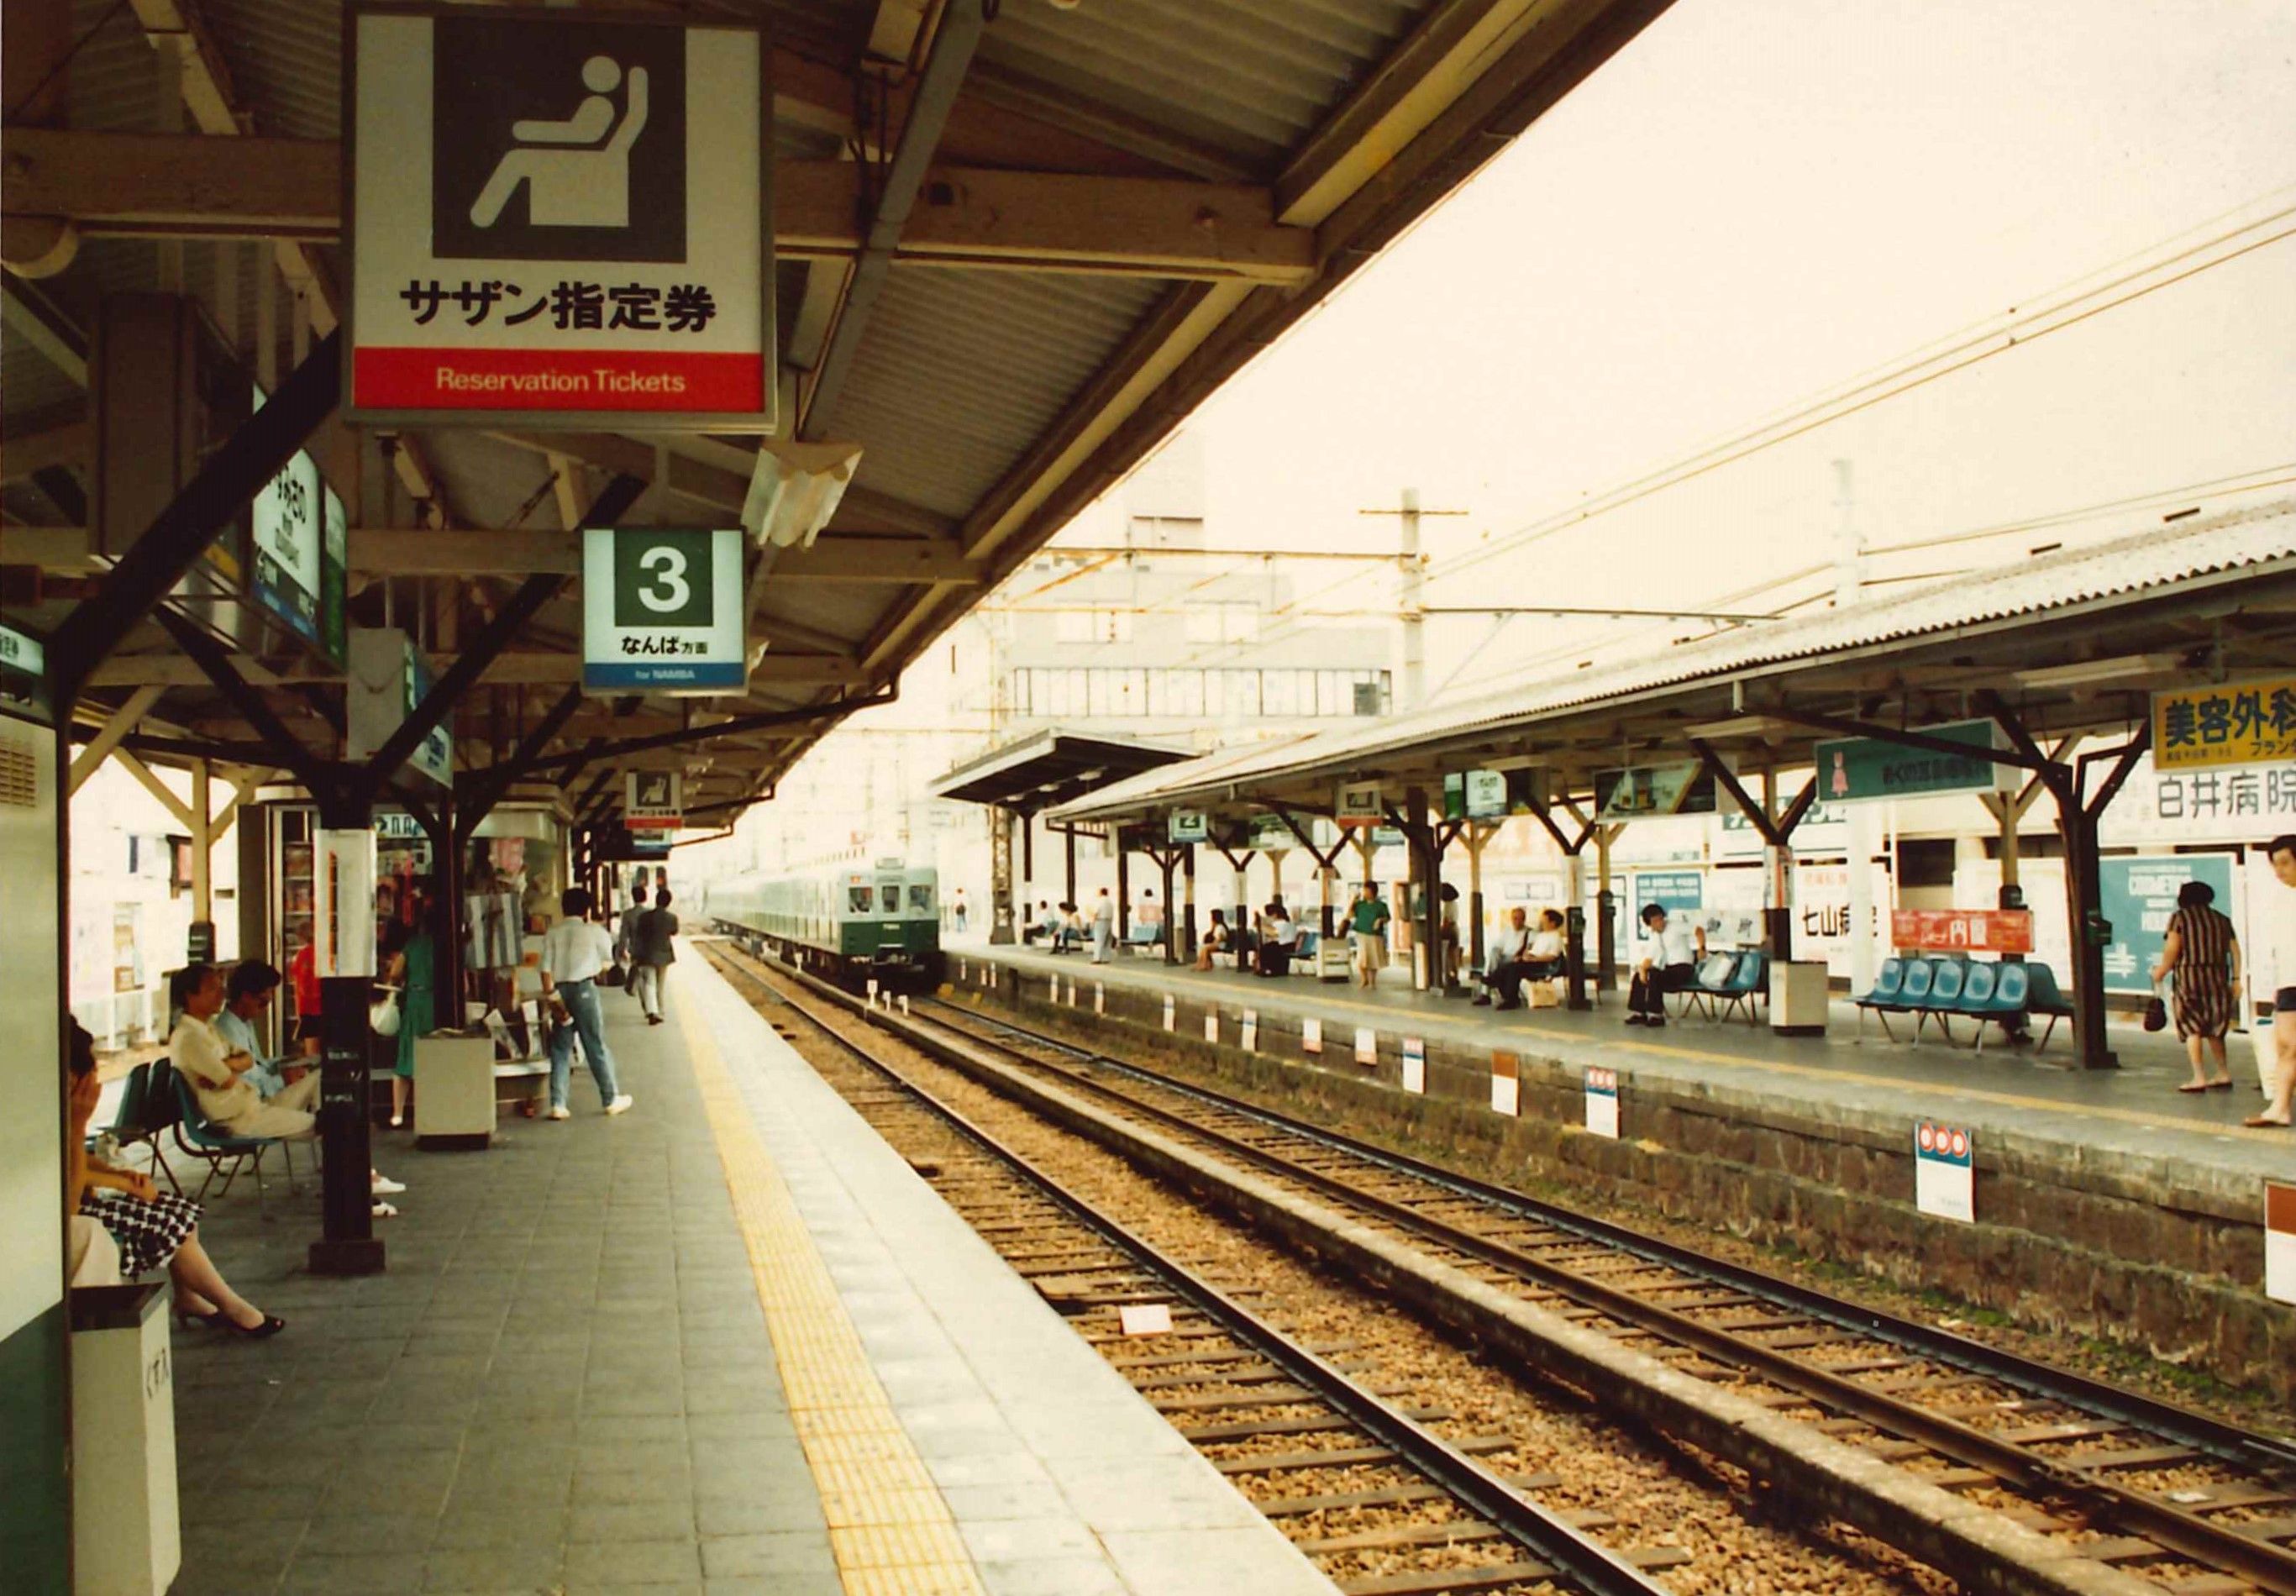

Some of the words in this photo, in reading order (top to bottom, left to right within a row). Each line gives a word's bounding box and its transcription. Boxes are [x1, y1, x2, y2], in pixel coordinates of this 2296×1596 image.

[401, 280, 715, 332] サザン指定券
[436, 368, 589, 392] Reservation
[593, 370, 686, 393] Tickets
[637, 546, 691, 613] 3
[622, 635, 708, 655] なんば方面
[2158, 769, 2296, 820] 白井病院
